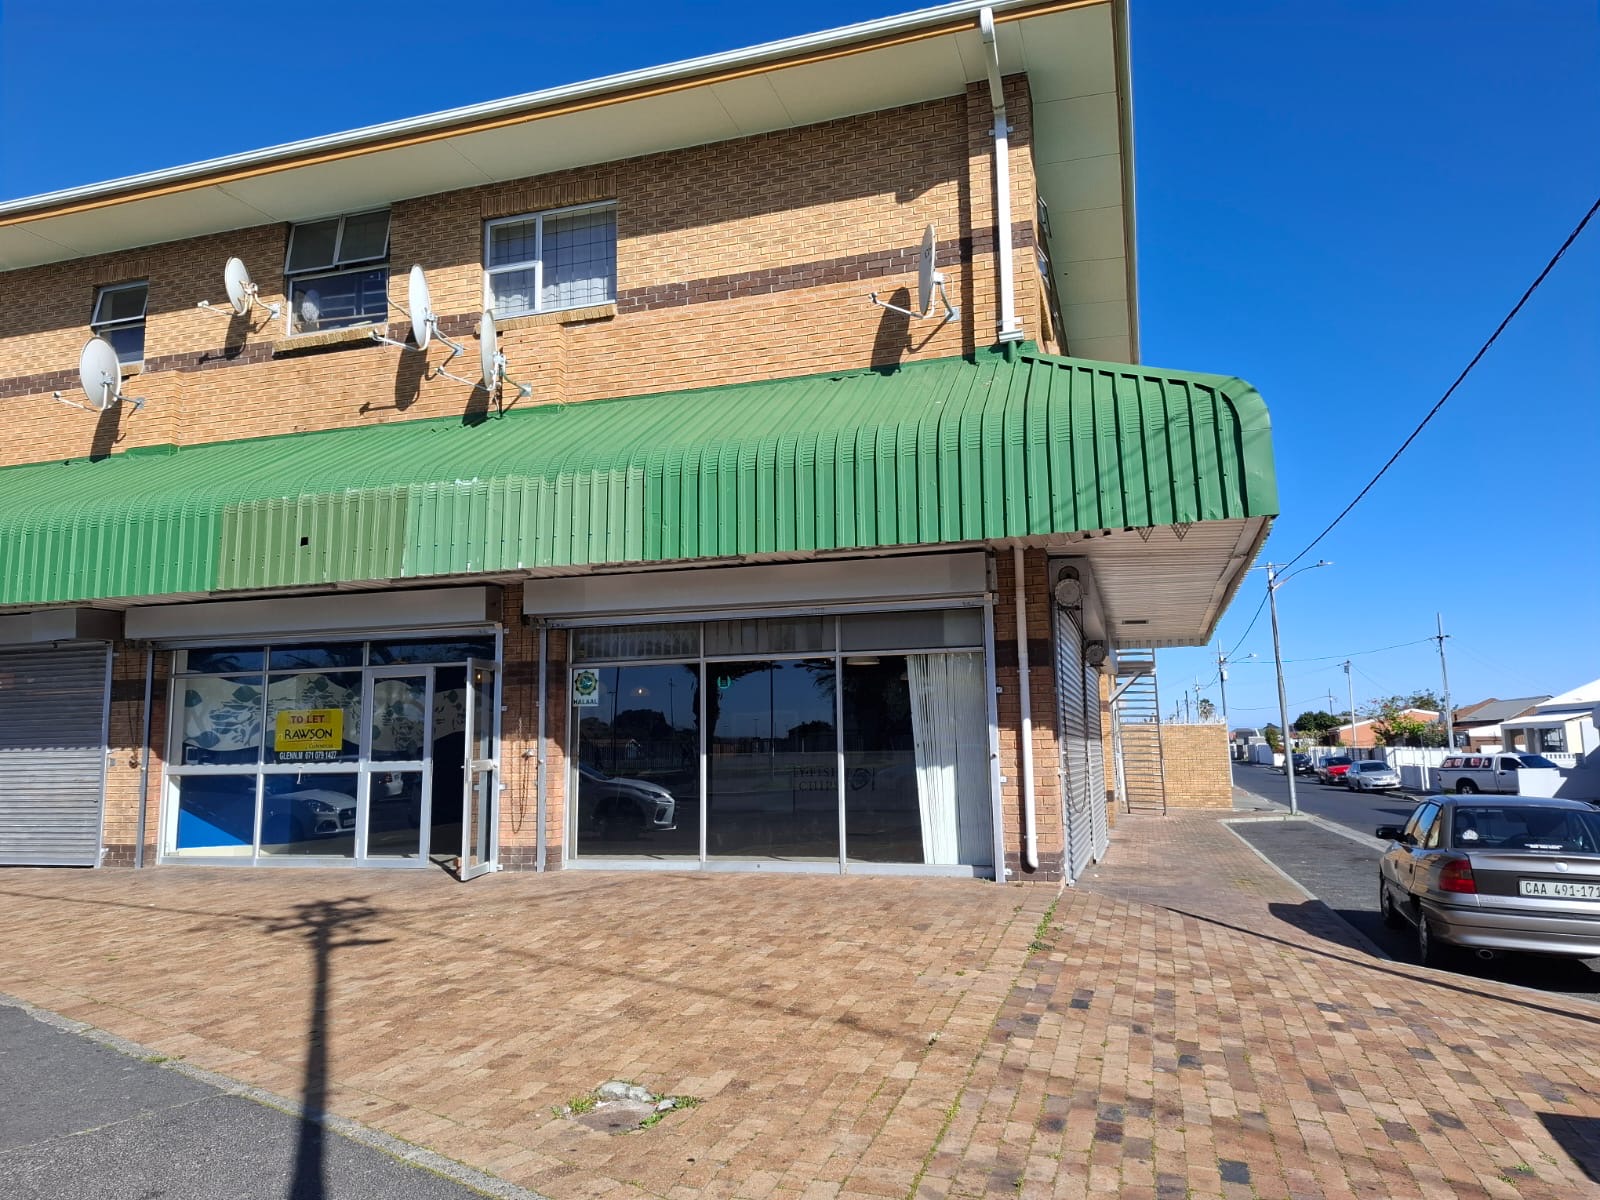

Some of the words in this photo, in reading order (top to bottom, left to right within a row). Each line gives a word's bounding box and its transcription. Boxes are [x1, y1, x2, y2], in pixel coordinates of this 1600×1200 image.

[290, 715, 304, 724] TO
[306, 715, 325, 724] LET
[284, 728, 333, 739] RAWSON
[304, 751, 314, 760] 071
[1525, 882, 1547, 895] CAA
